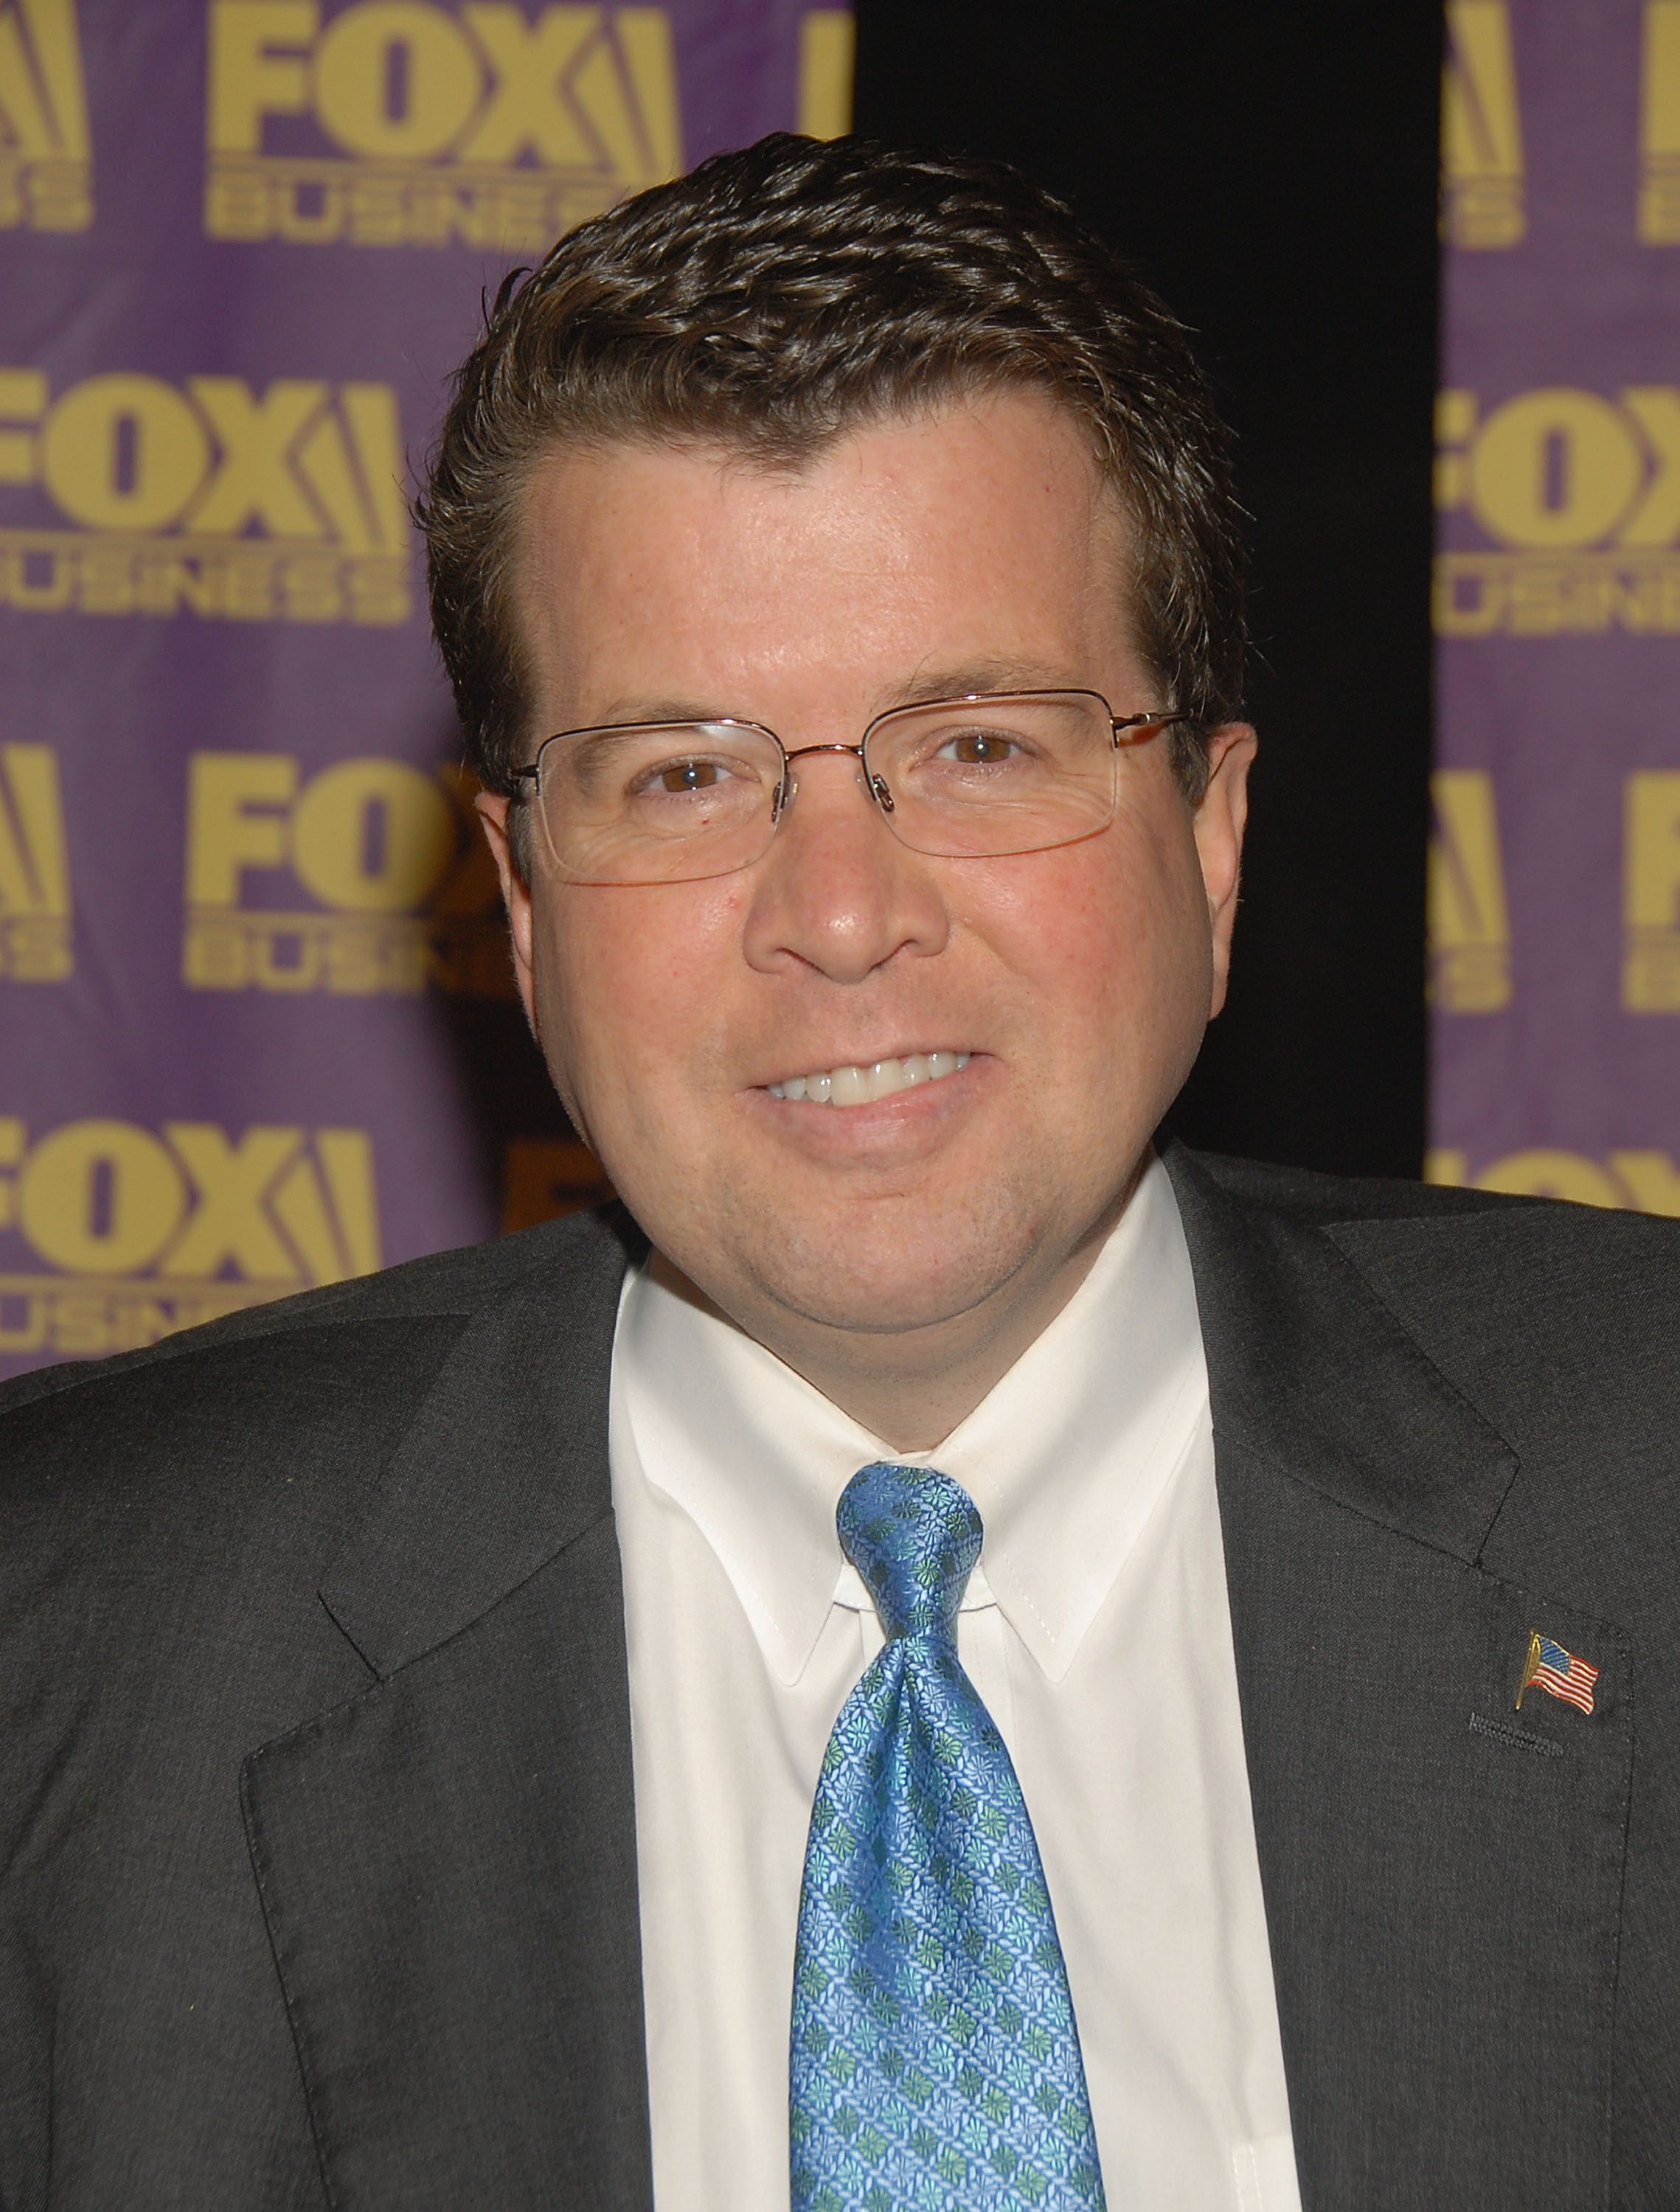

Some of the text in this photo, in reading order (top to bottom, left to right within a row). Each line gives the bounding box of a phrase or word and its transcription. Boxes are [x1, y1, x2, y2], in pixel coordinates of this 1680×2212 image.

[207, 0, 609, 164] FOX
[204, 180, 633, 252] BUSINE
[0, 553, 412, 625] USINESS
[0, 1117, 304, 1279] OX
